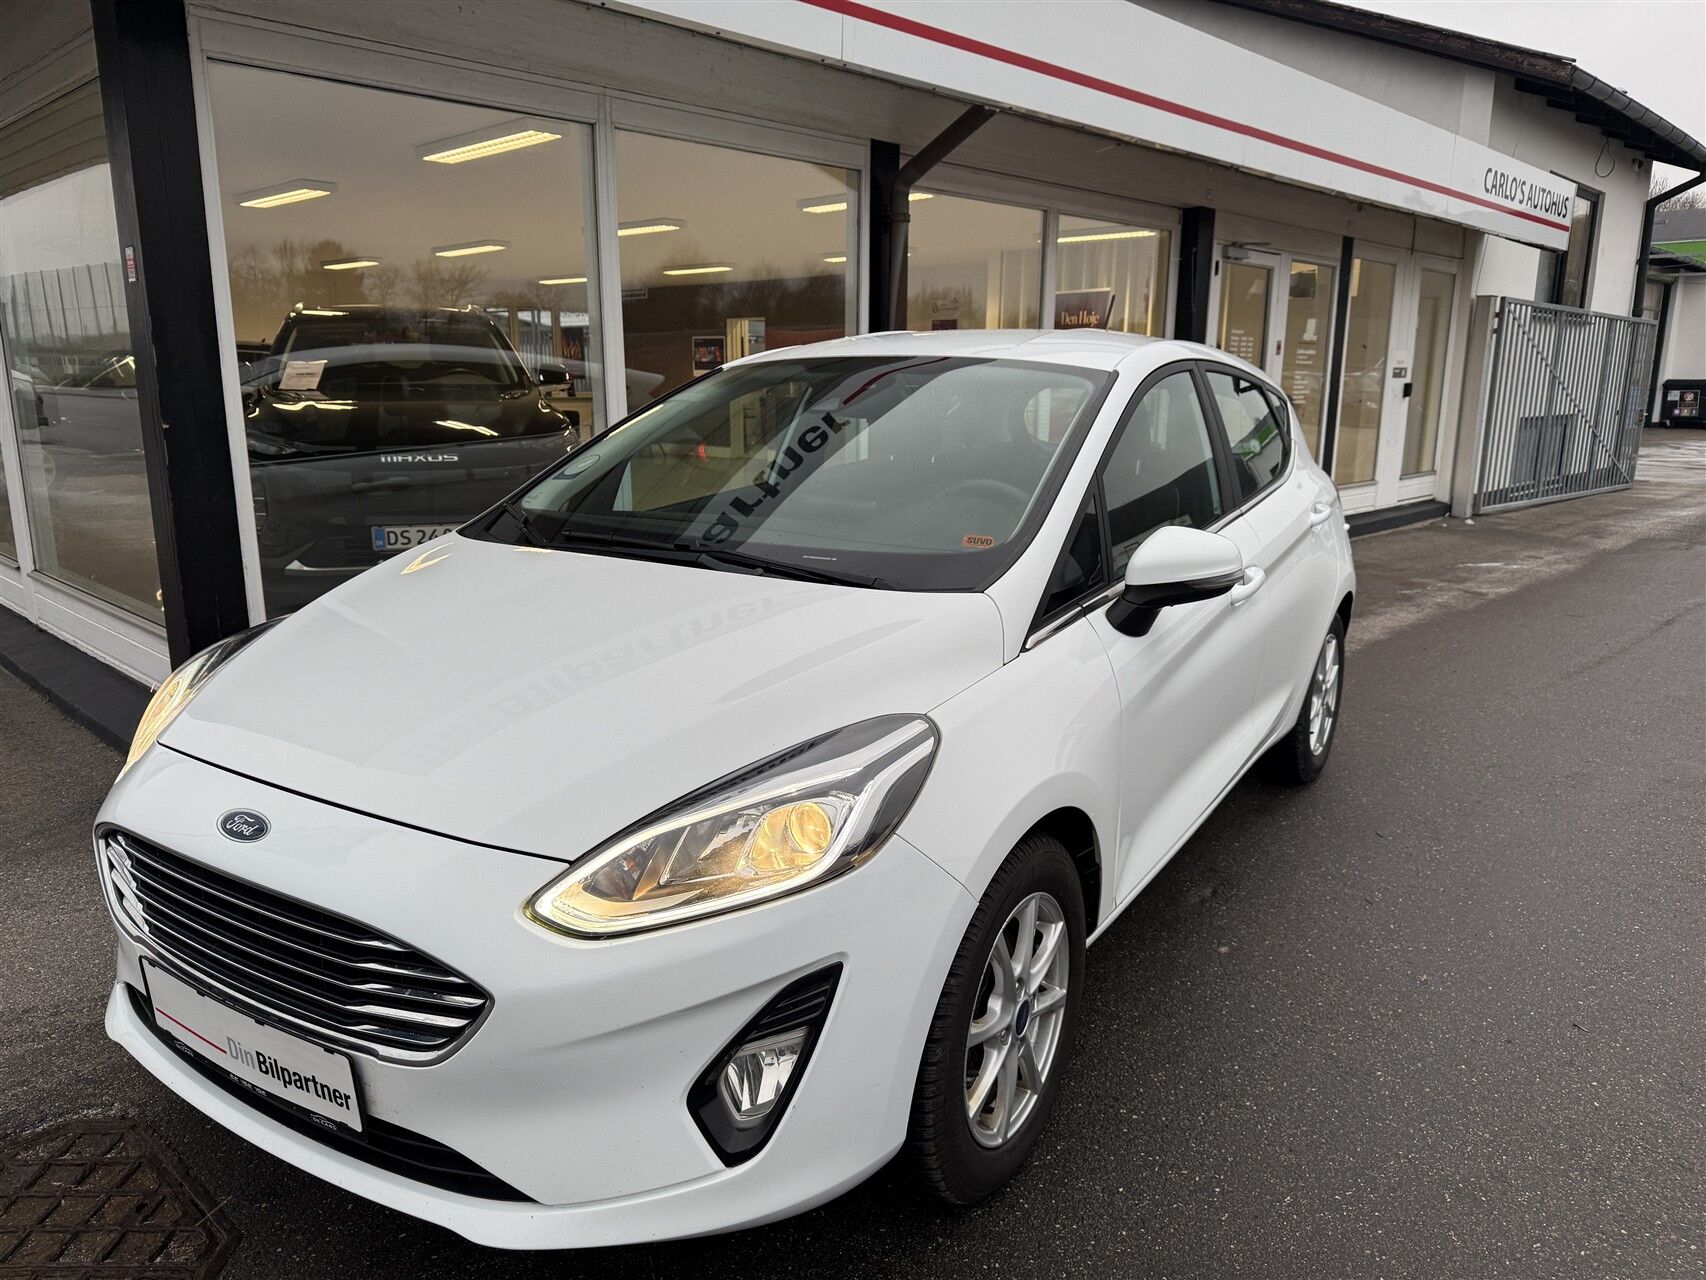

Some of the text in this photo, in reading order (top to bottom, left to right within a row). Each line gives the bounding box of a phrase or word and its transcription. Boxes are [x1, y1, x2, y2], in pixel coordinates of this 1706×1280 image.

[1483, 167, 1570, 219] CARLO'S AUTOHUS
[380, 453, 459, 463] MAXUS
[386, 529, 412, 546] DS
[966, 536, 993, 545] SUVO
[225, 814, 260, 836] Ford
